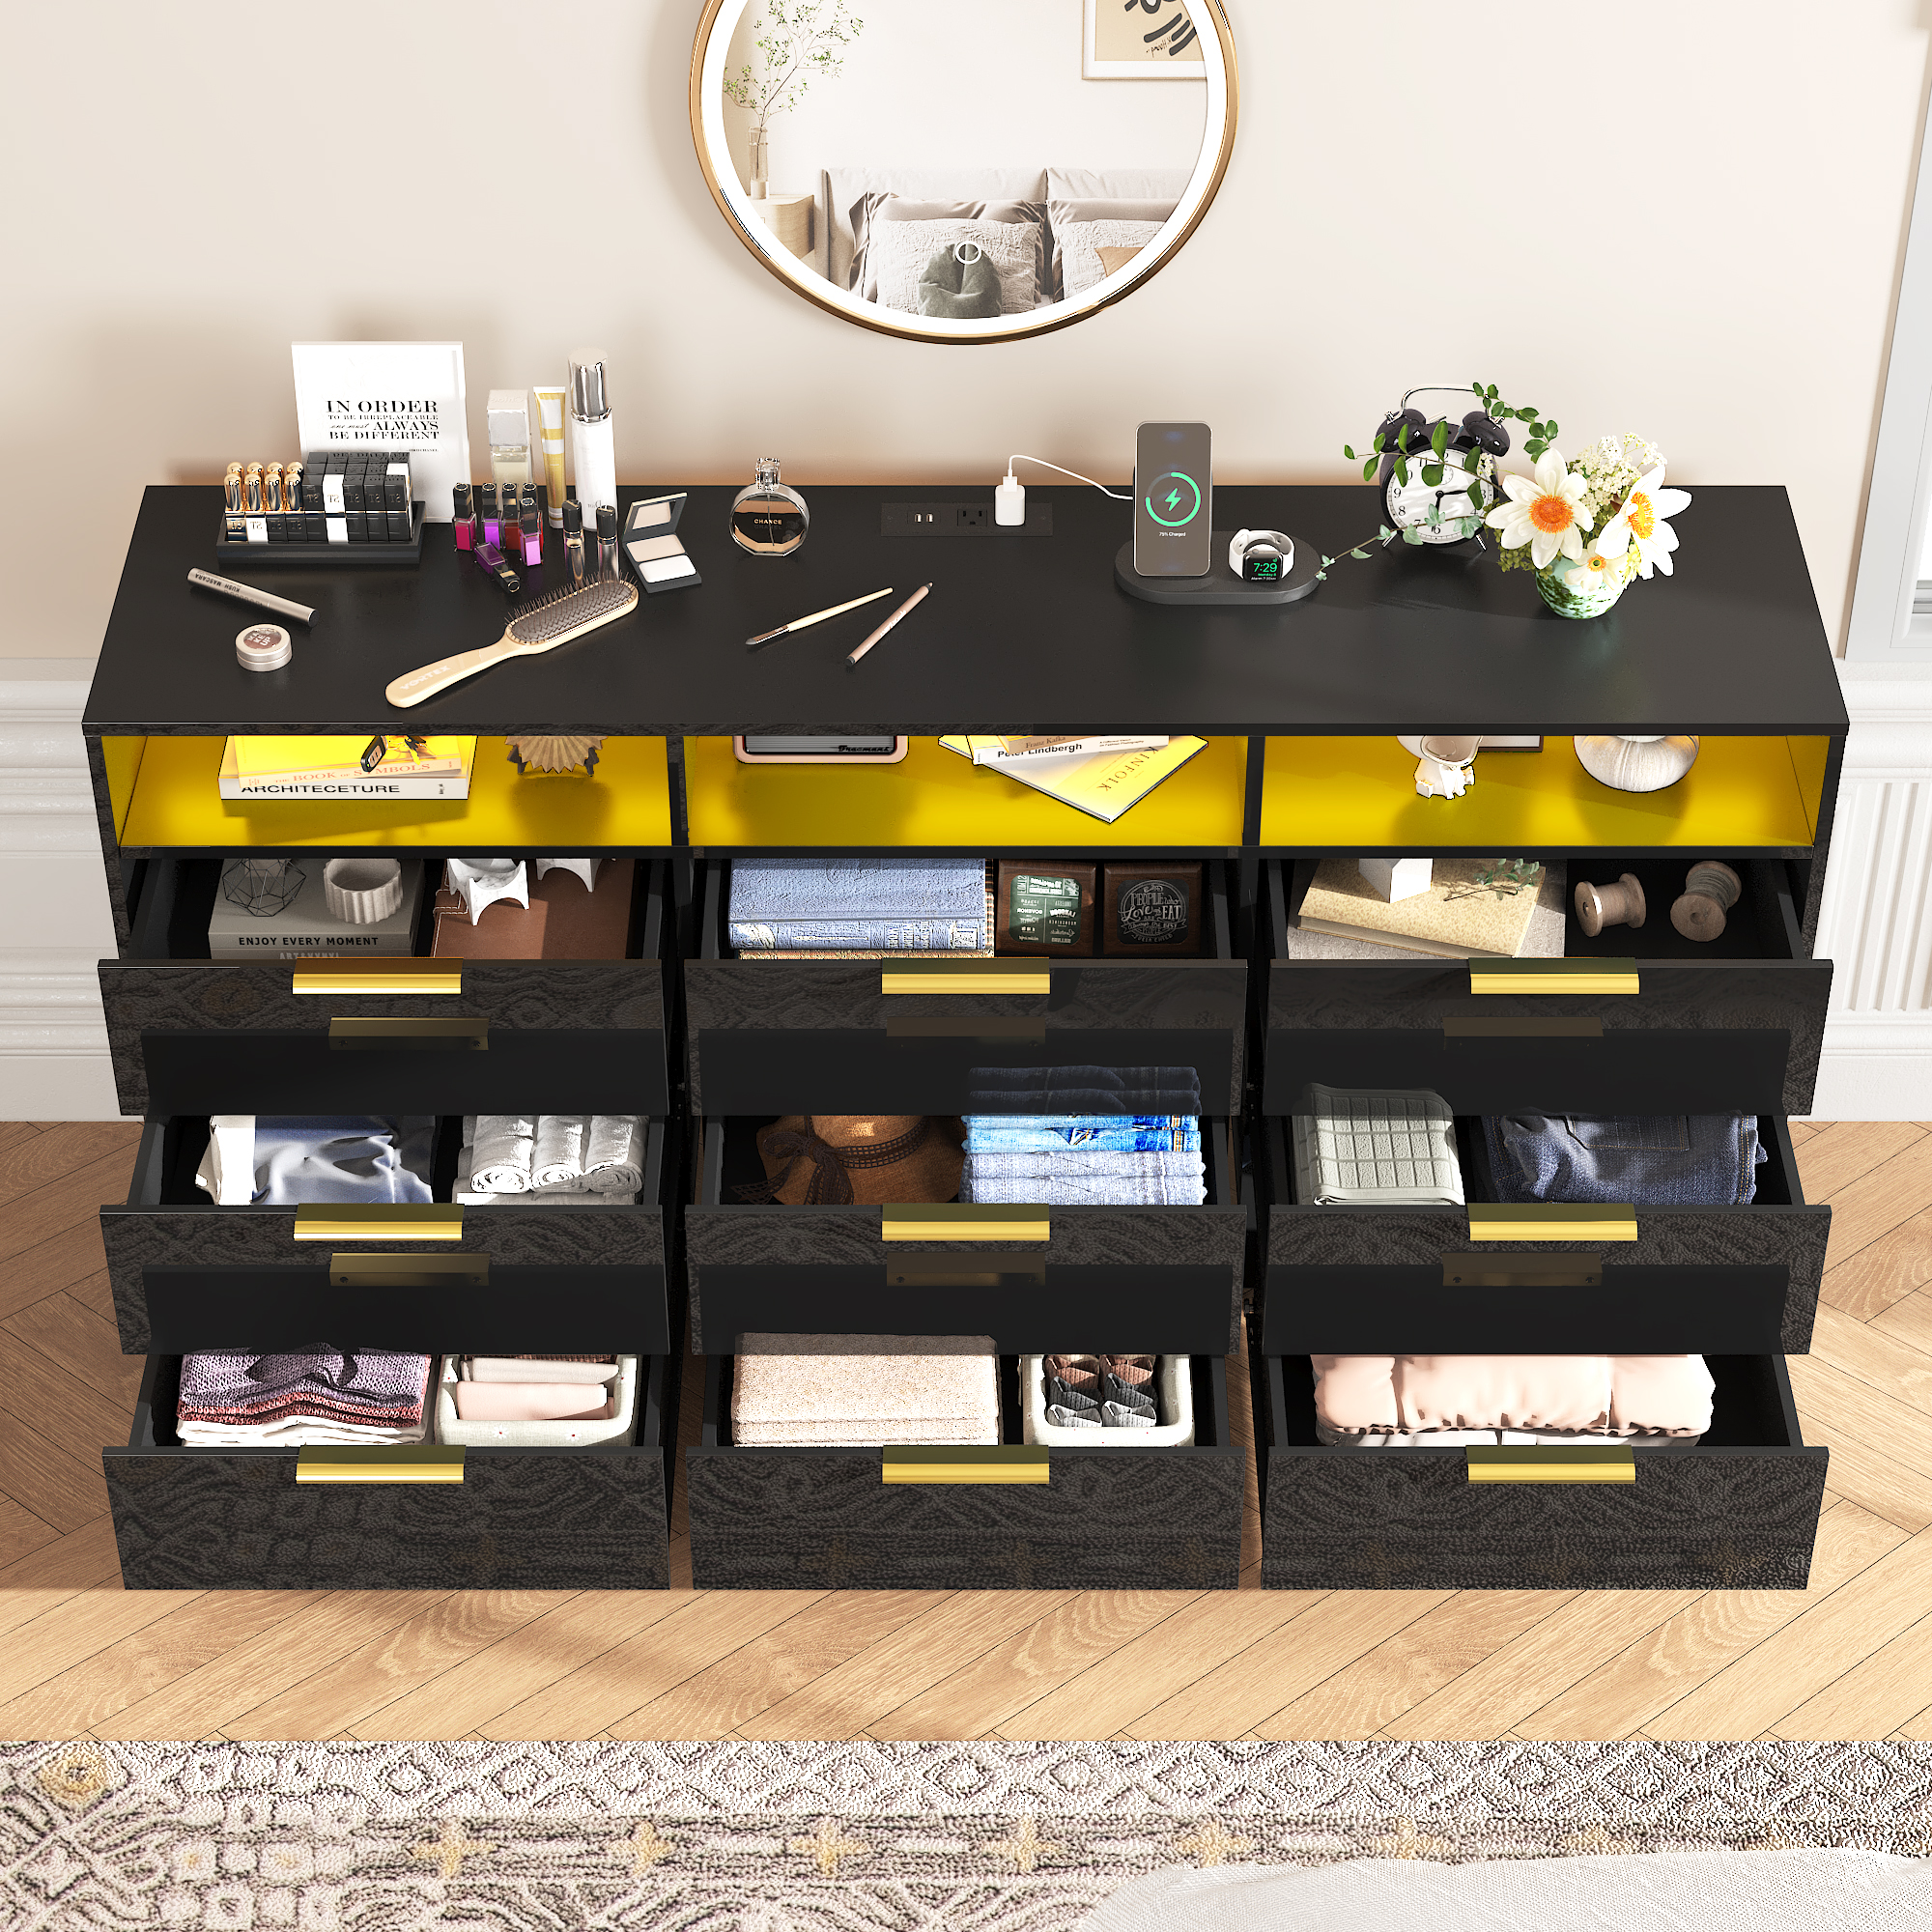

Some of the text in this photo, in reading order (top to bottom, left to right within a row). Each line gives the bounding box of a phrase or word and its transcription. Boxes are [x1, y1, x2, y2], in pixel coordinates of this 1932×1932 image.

[327, 400, 439, 413] IN ORDER
[373, 420, 440, 431] ALWAYS
[329, 431, 440, 440] BE DIFFERENT
[1393, 487, 1402, 498] 9
[1398, 505, 1406, 517] 8
[1253, 562, 1278, 573] 7:29
[195, 573, 241, 593] KUSH MASCARA
[399, 666, 451, 690] VORTEX
[1025, 735, 1066, 749] Franz Kafka
[1028, 743, 1083, 754] Lindbergh
[293, 772, 337, 781] BOOK
[354, 763, 431, 777] SMBOLS
[1096, 746, 1159, 792] KINFOLK
[241, 784, 401, 793] ARCHITECETURE
[1162, 904, 1181, 920] EAT
[239, 936, 379, 947] ENJOY EVERY MOMENT
